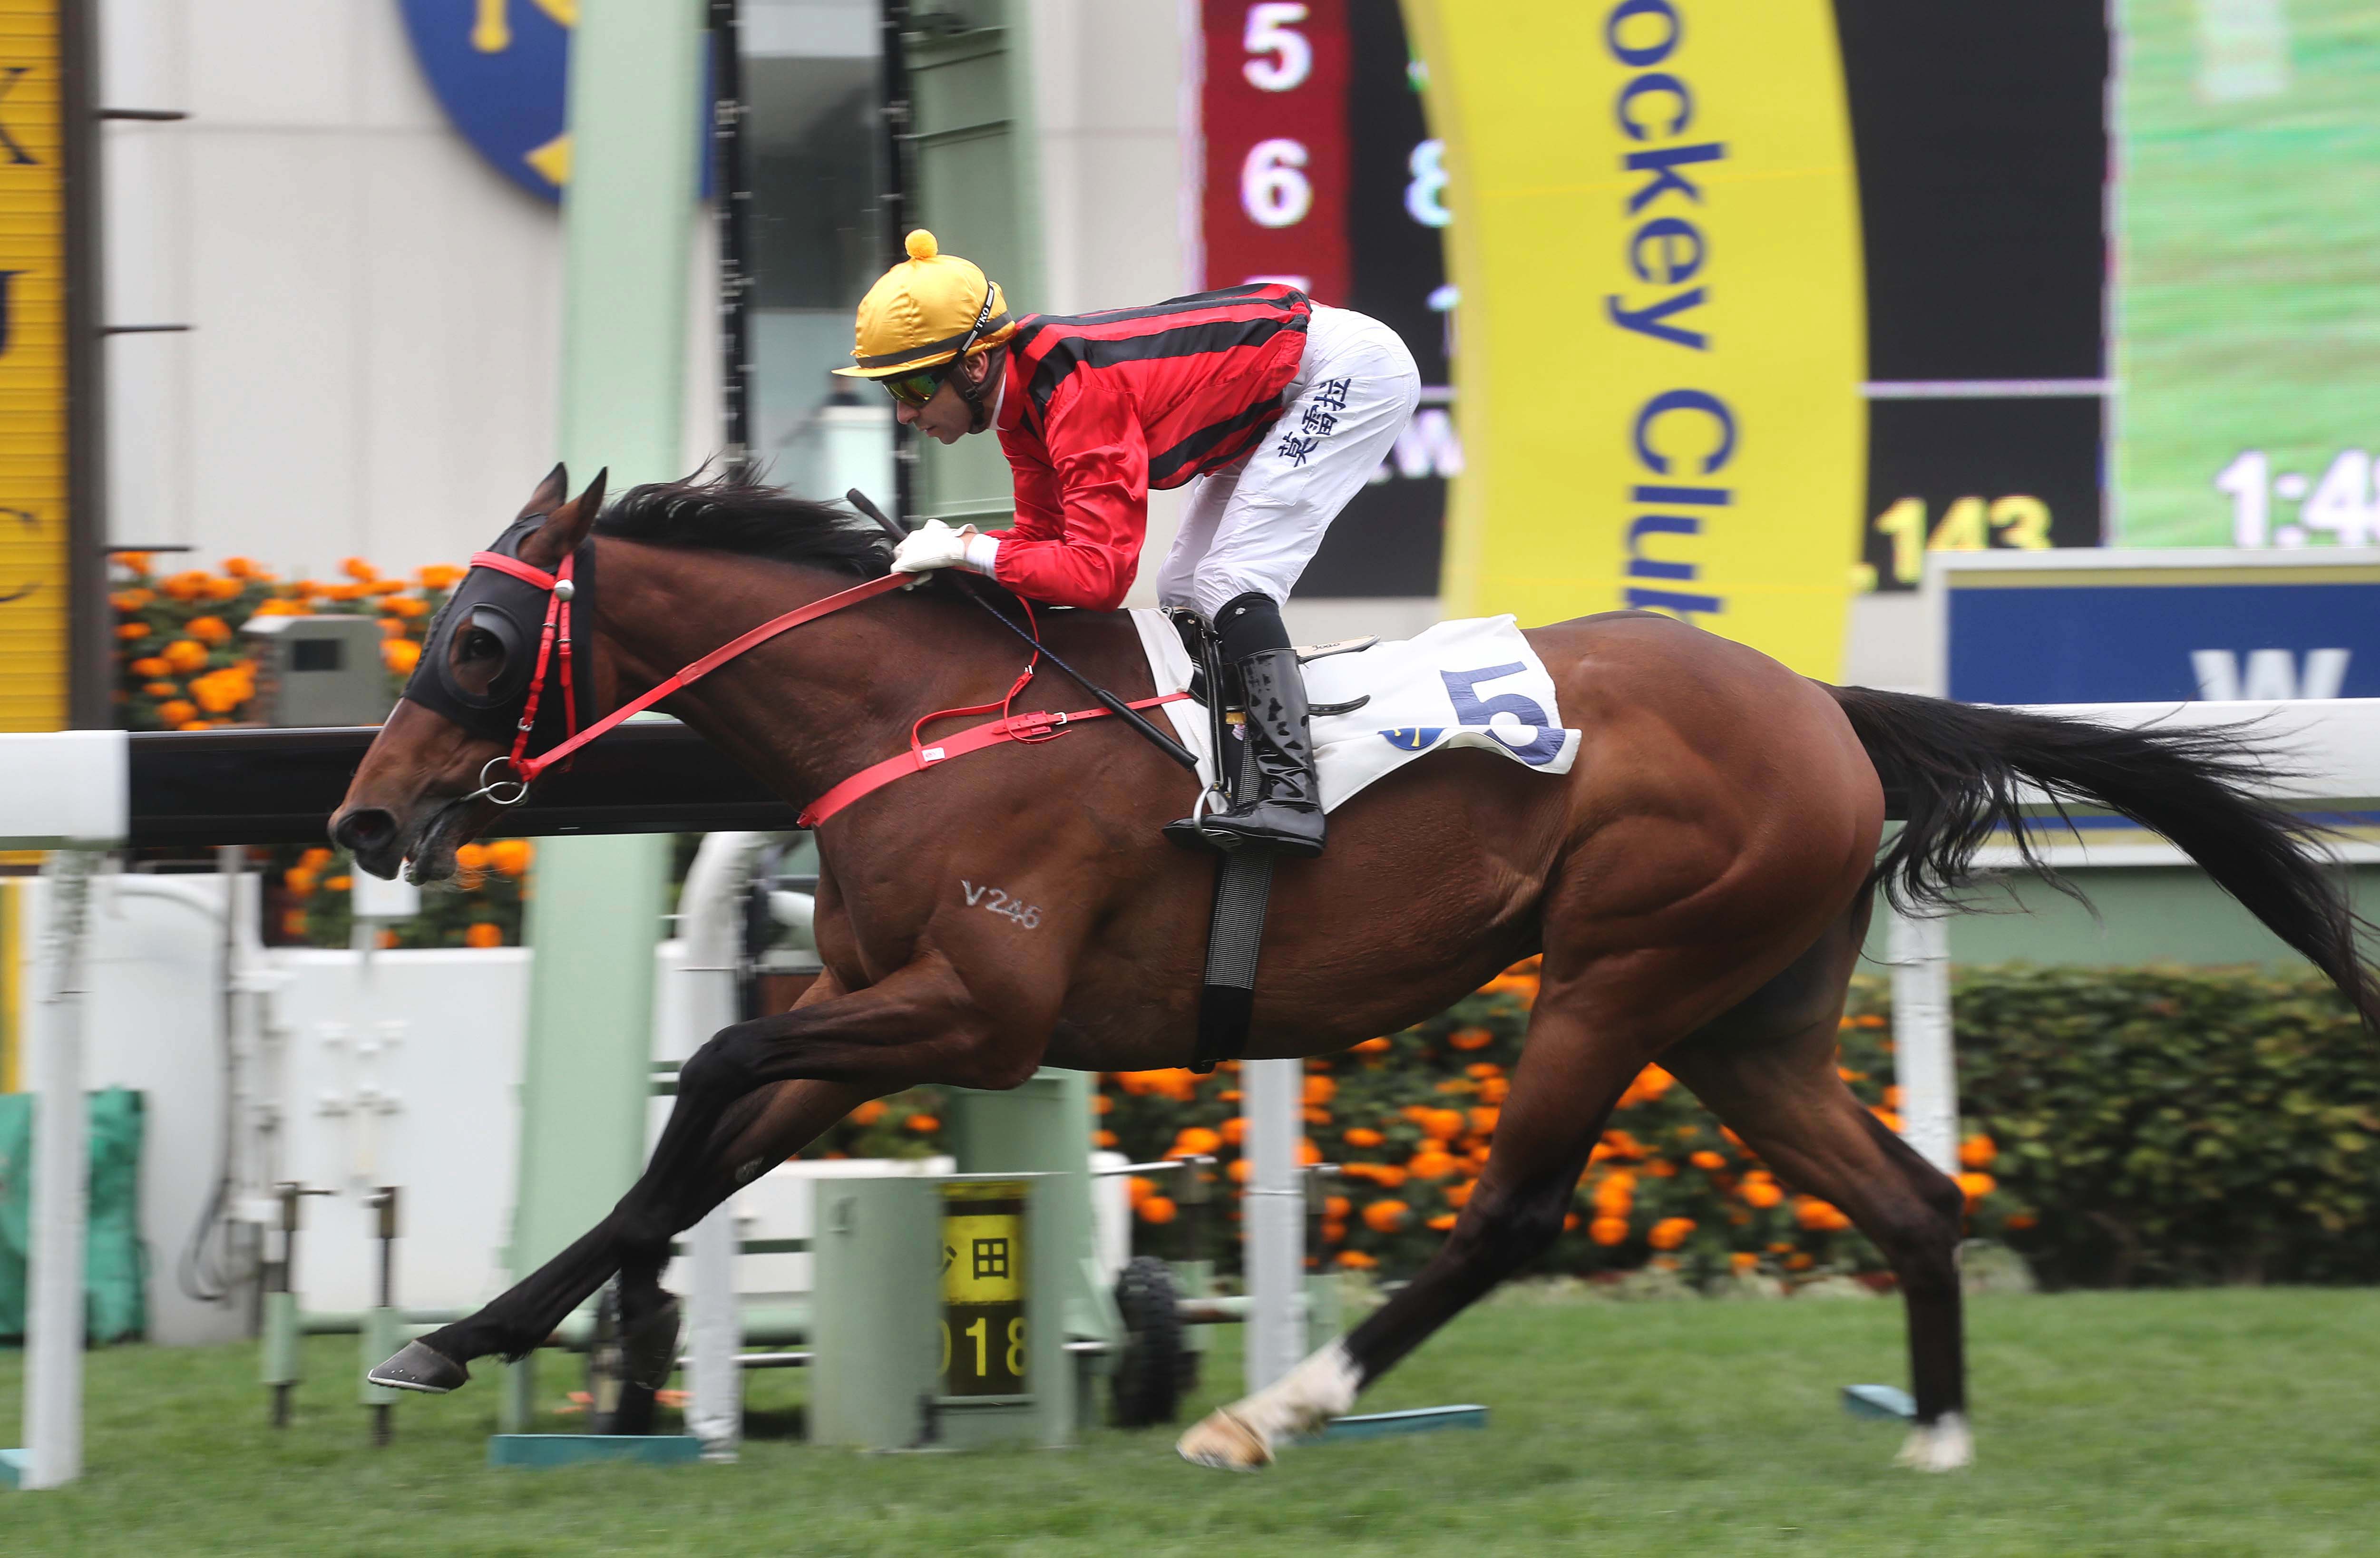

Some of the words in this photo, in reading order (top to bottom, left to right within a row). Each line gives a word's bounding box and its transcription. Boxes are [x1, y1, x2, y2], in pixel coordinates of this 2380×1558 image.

[1242, 1, 1314, 92] 5
[1240, 138, 1314, 228] 6
[975, 307, 989, 328] TKO
[1278, 378, 1352, 467] 莫雷拉
[2213, 448, 2380, 548] 1:4
[1440, 661, 1566, 765] 5
[961, 879, 1043, 929] V246
